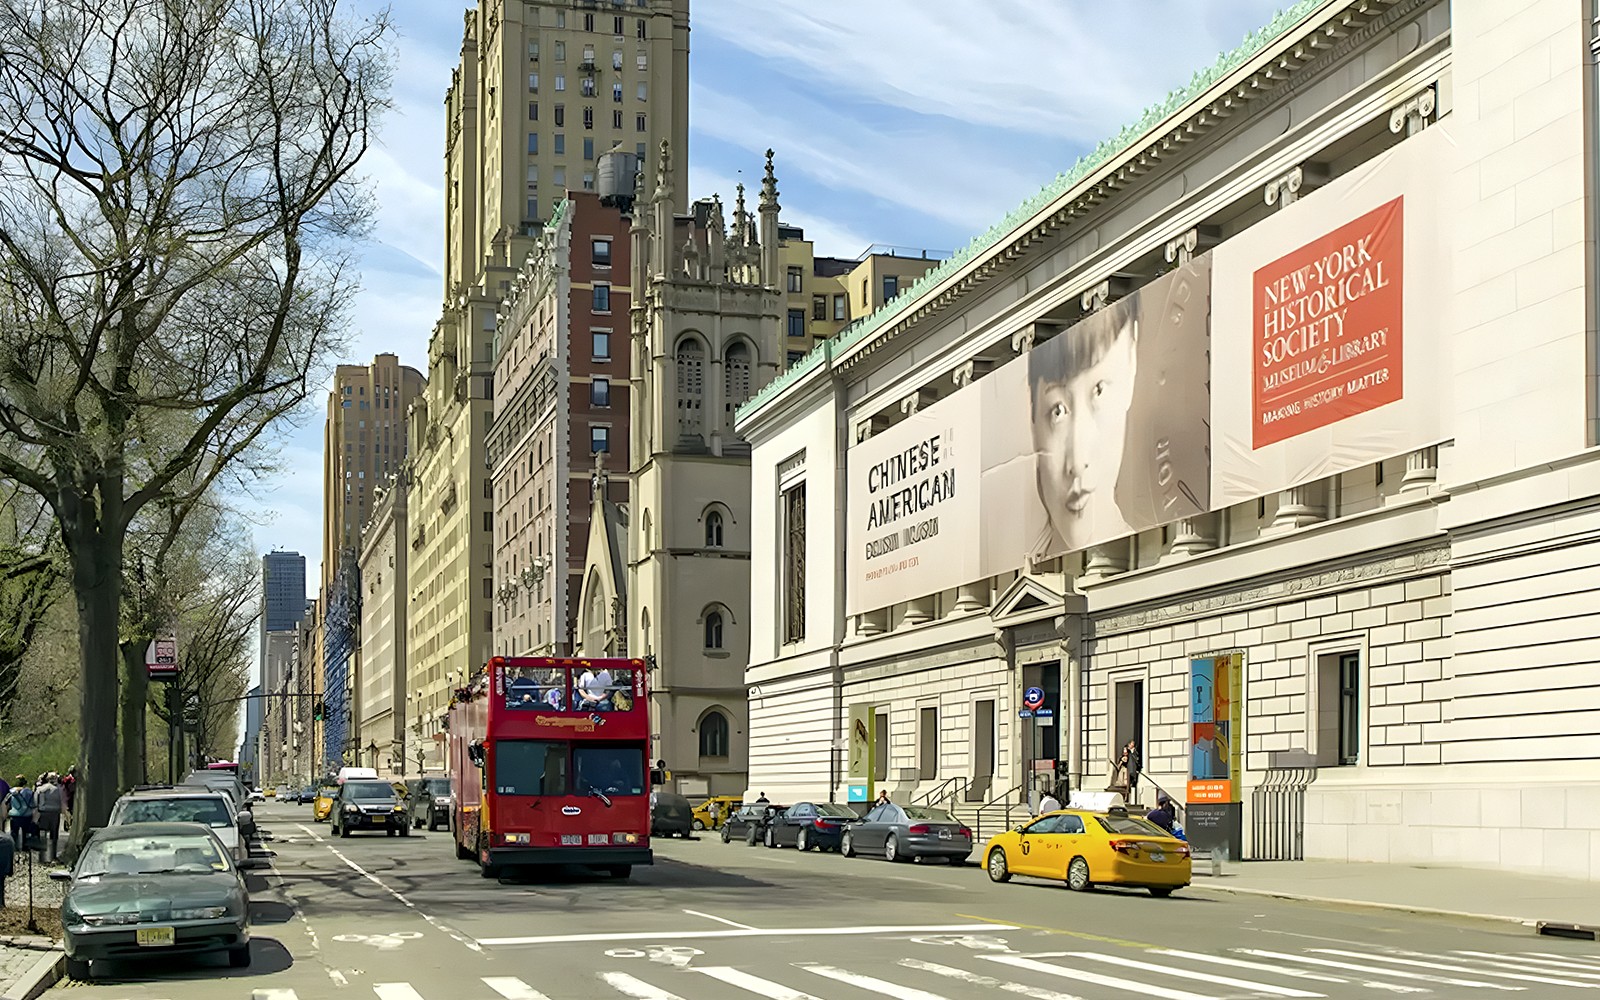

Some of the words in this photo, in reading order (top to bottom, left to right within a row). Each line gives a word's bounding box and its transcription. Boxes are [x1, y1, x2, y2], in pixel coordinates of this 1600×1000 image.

[1263, 261, 1389, 340] HISTORICAL
[1264, 233, 1373, 310] NEW-YORK
[1262, 308, 1348, 368] SOCIETY
[868, 434, 940, 494] CHINESE
[867, 468, 956, 531] AMERICAN
